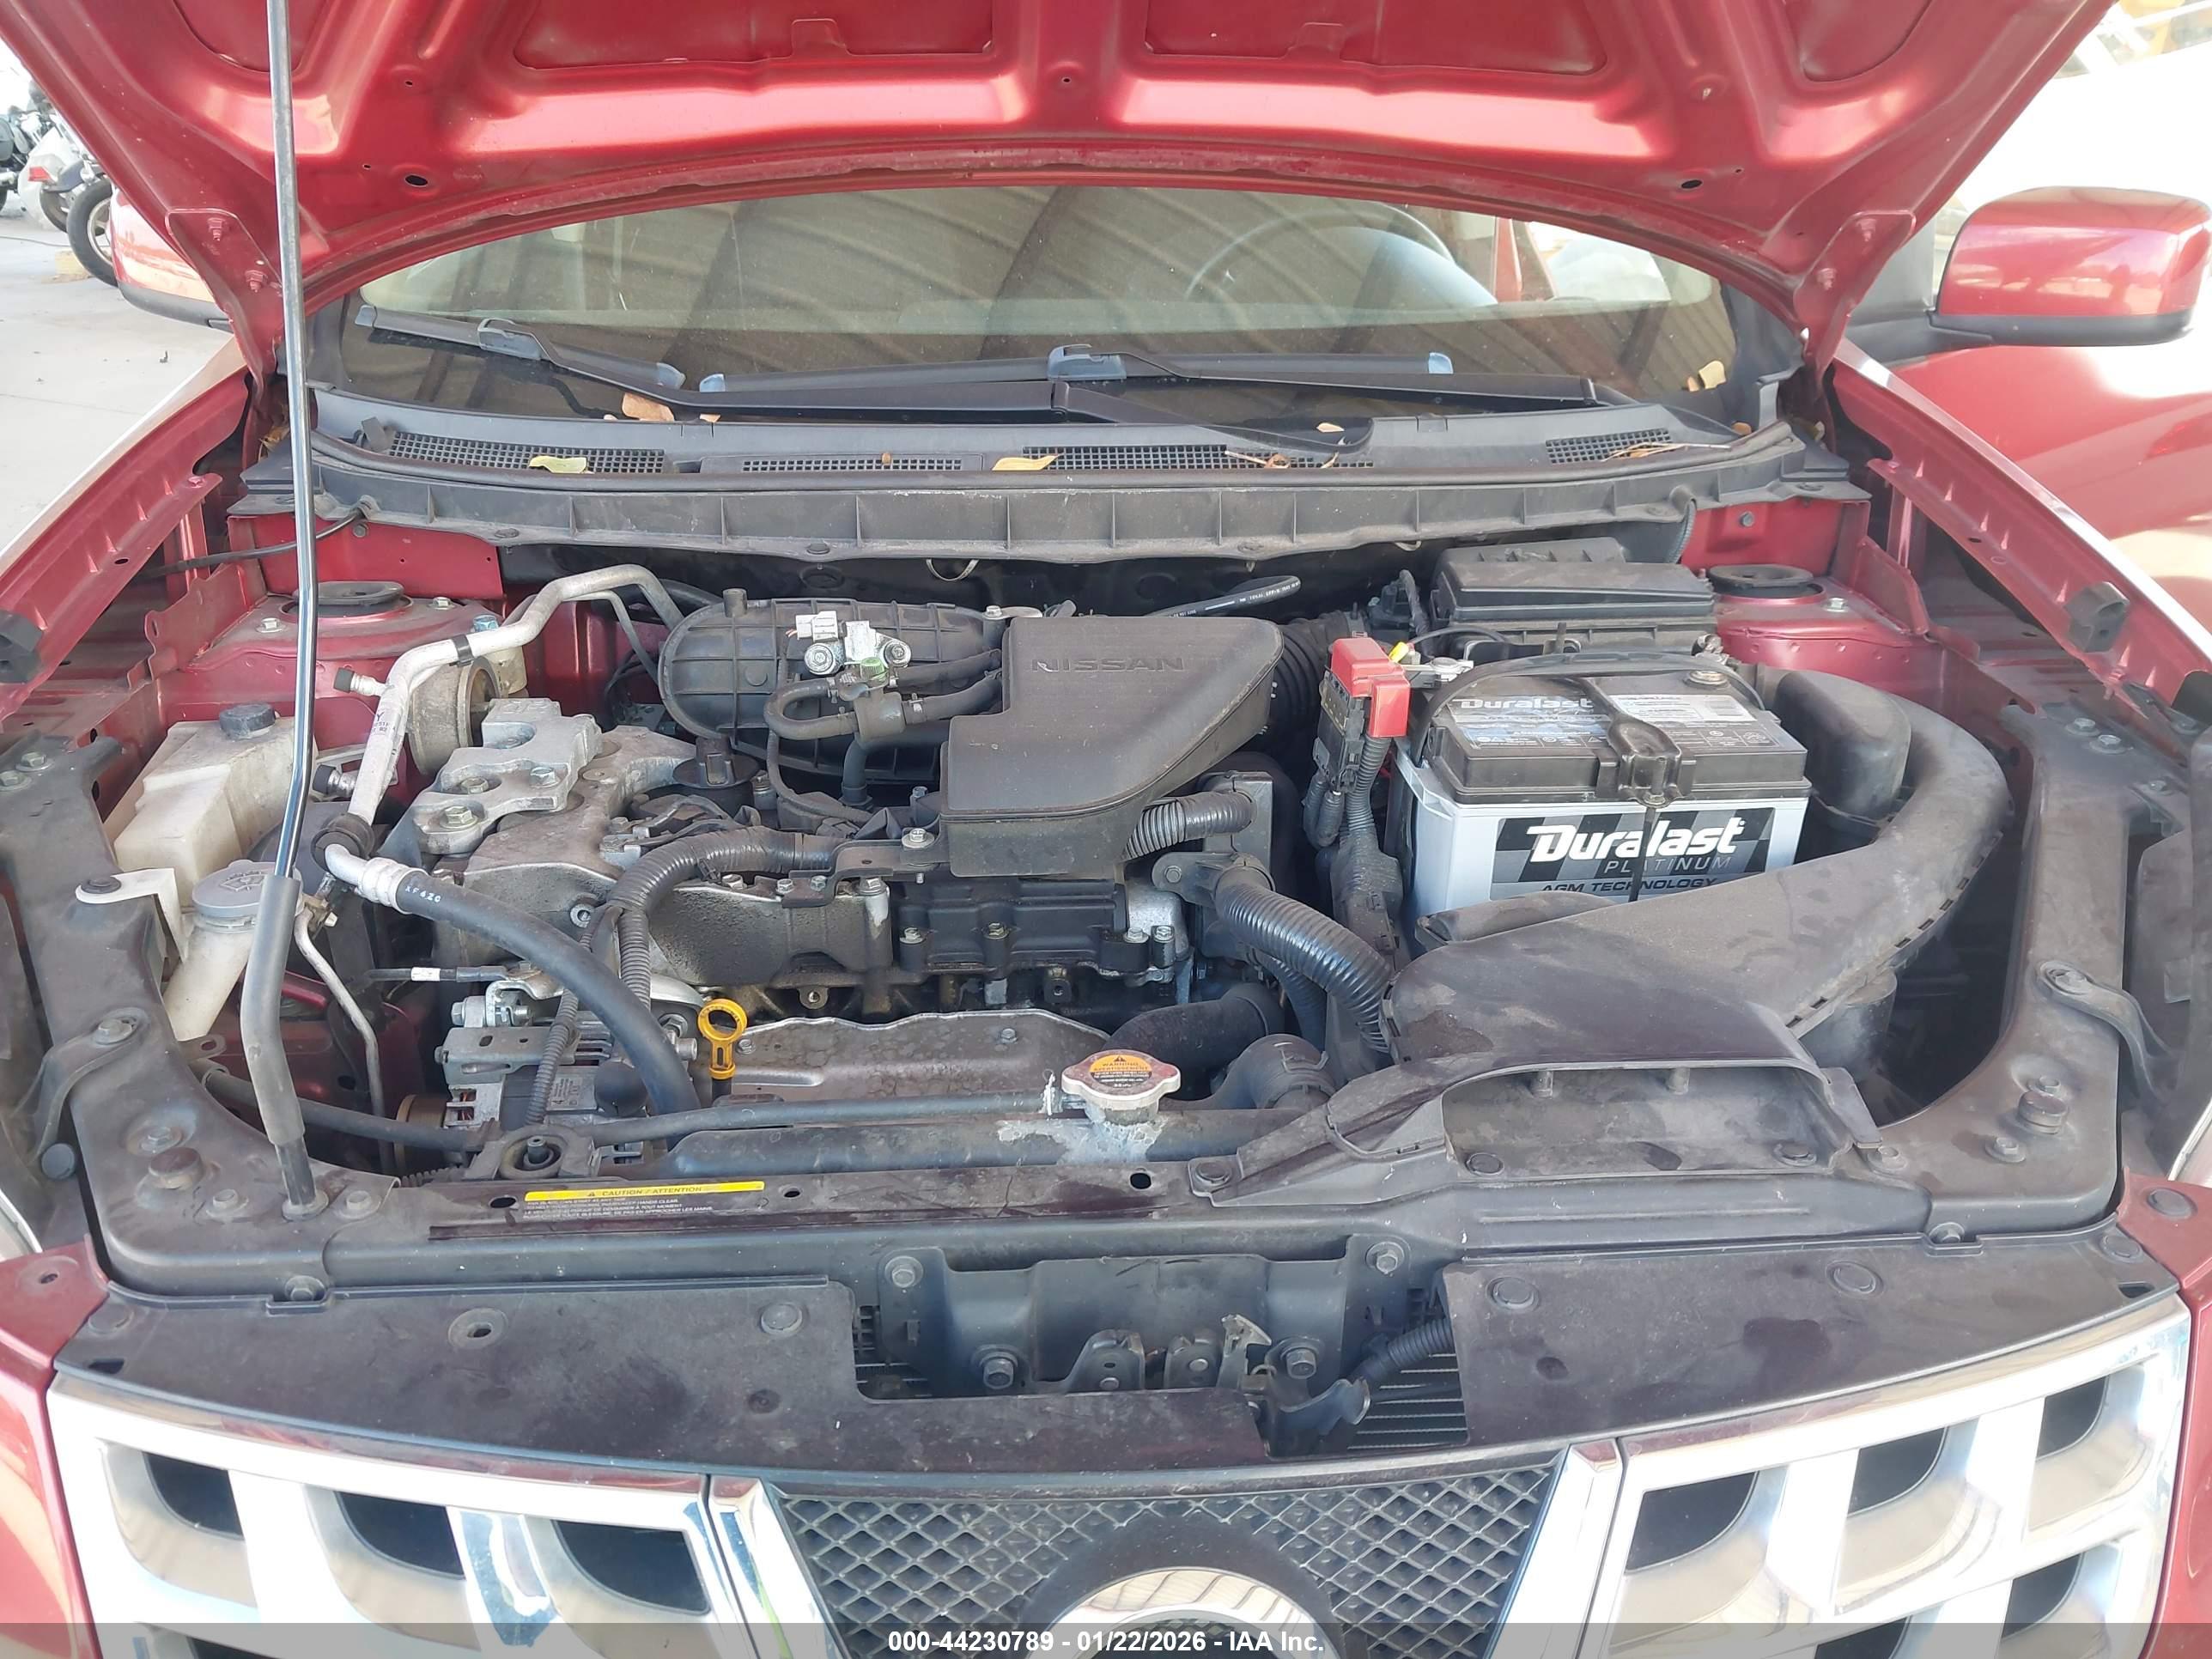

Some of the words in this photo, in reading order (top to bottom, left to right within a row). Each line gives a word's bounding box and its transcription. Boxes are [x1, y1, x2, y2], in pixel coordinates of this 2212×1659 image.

[1031, 657, 1184, 672] NISSAN
[1452, 697, 1594, 709] Duralast
[1526, 817, 1746, 863] Duralast
